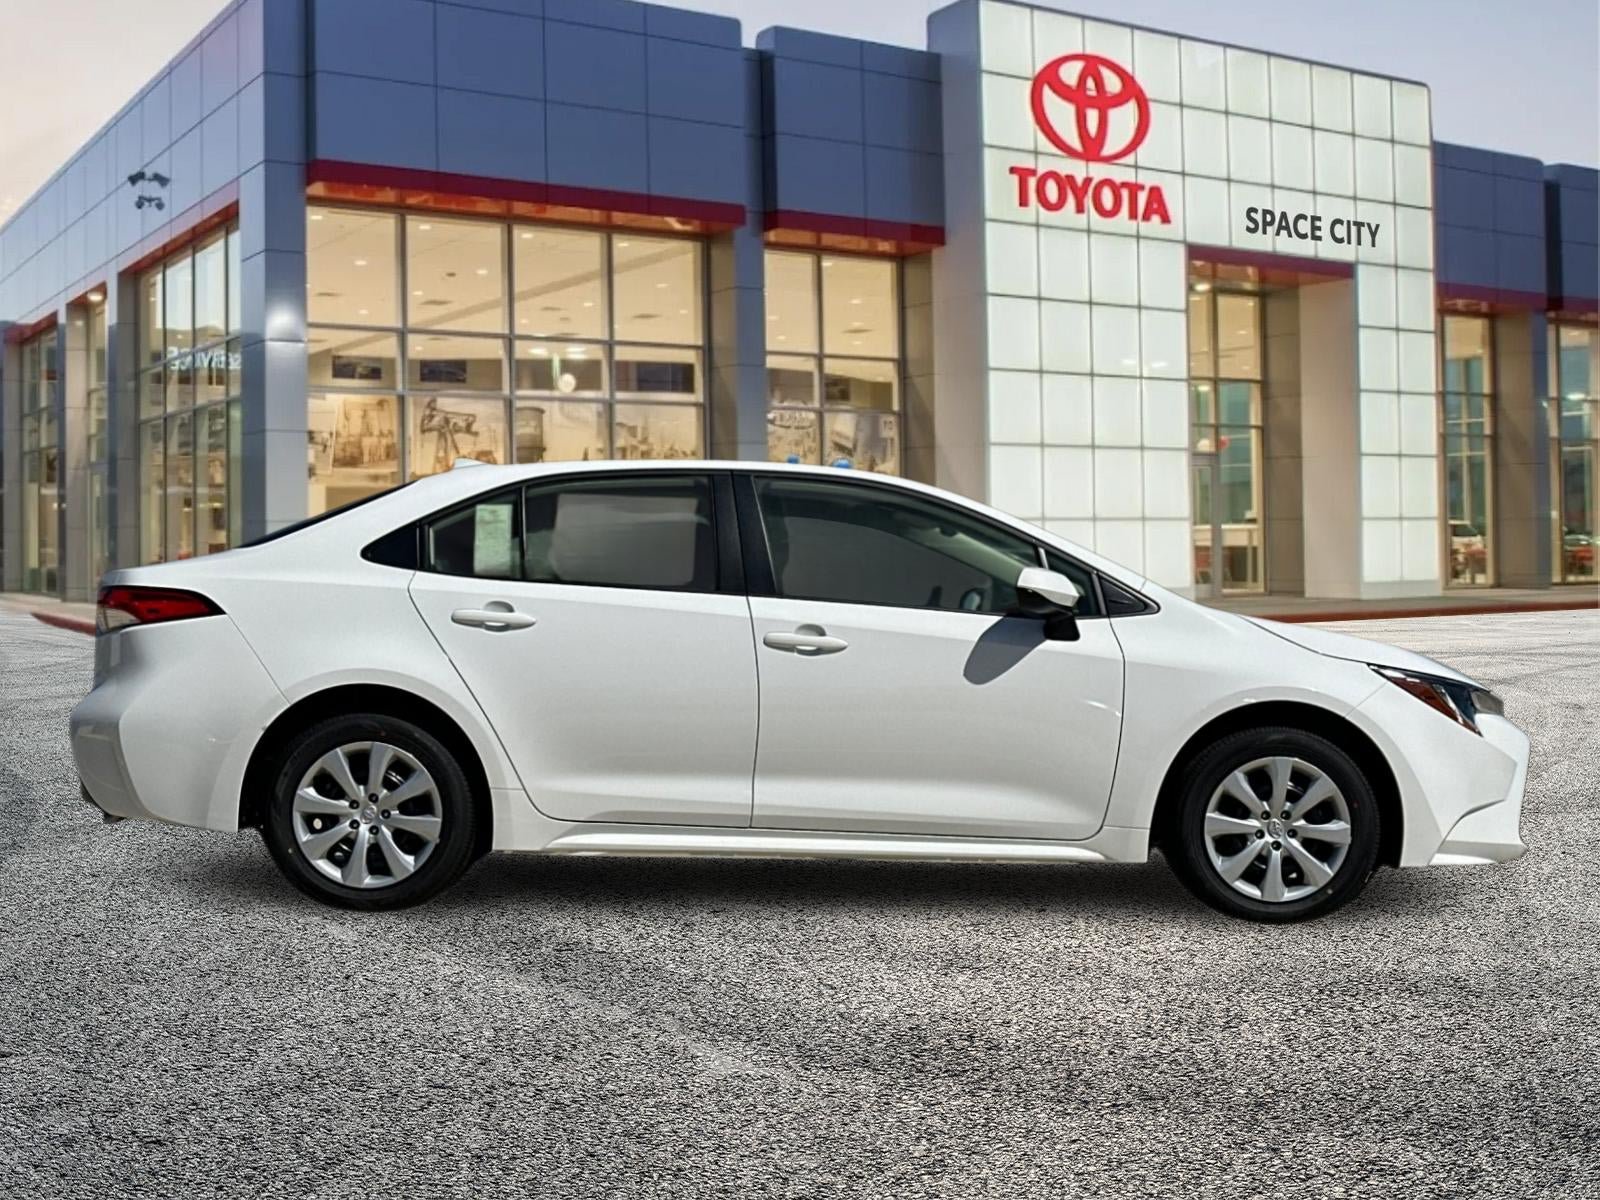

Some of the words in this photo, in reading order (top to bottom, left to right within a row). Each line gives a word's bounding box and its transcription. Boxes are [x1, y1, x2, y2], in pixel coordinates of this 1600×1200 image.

[1009, 166, 1171, 224] TOYOTA
[1245, 206, 1322, 242] SPACE
[1329, 217, 1380, 248] CITY
